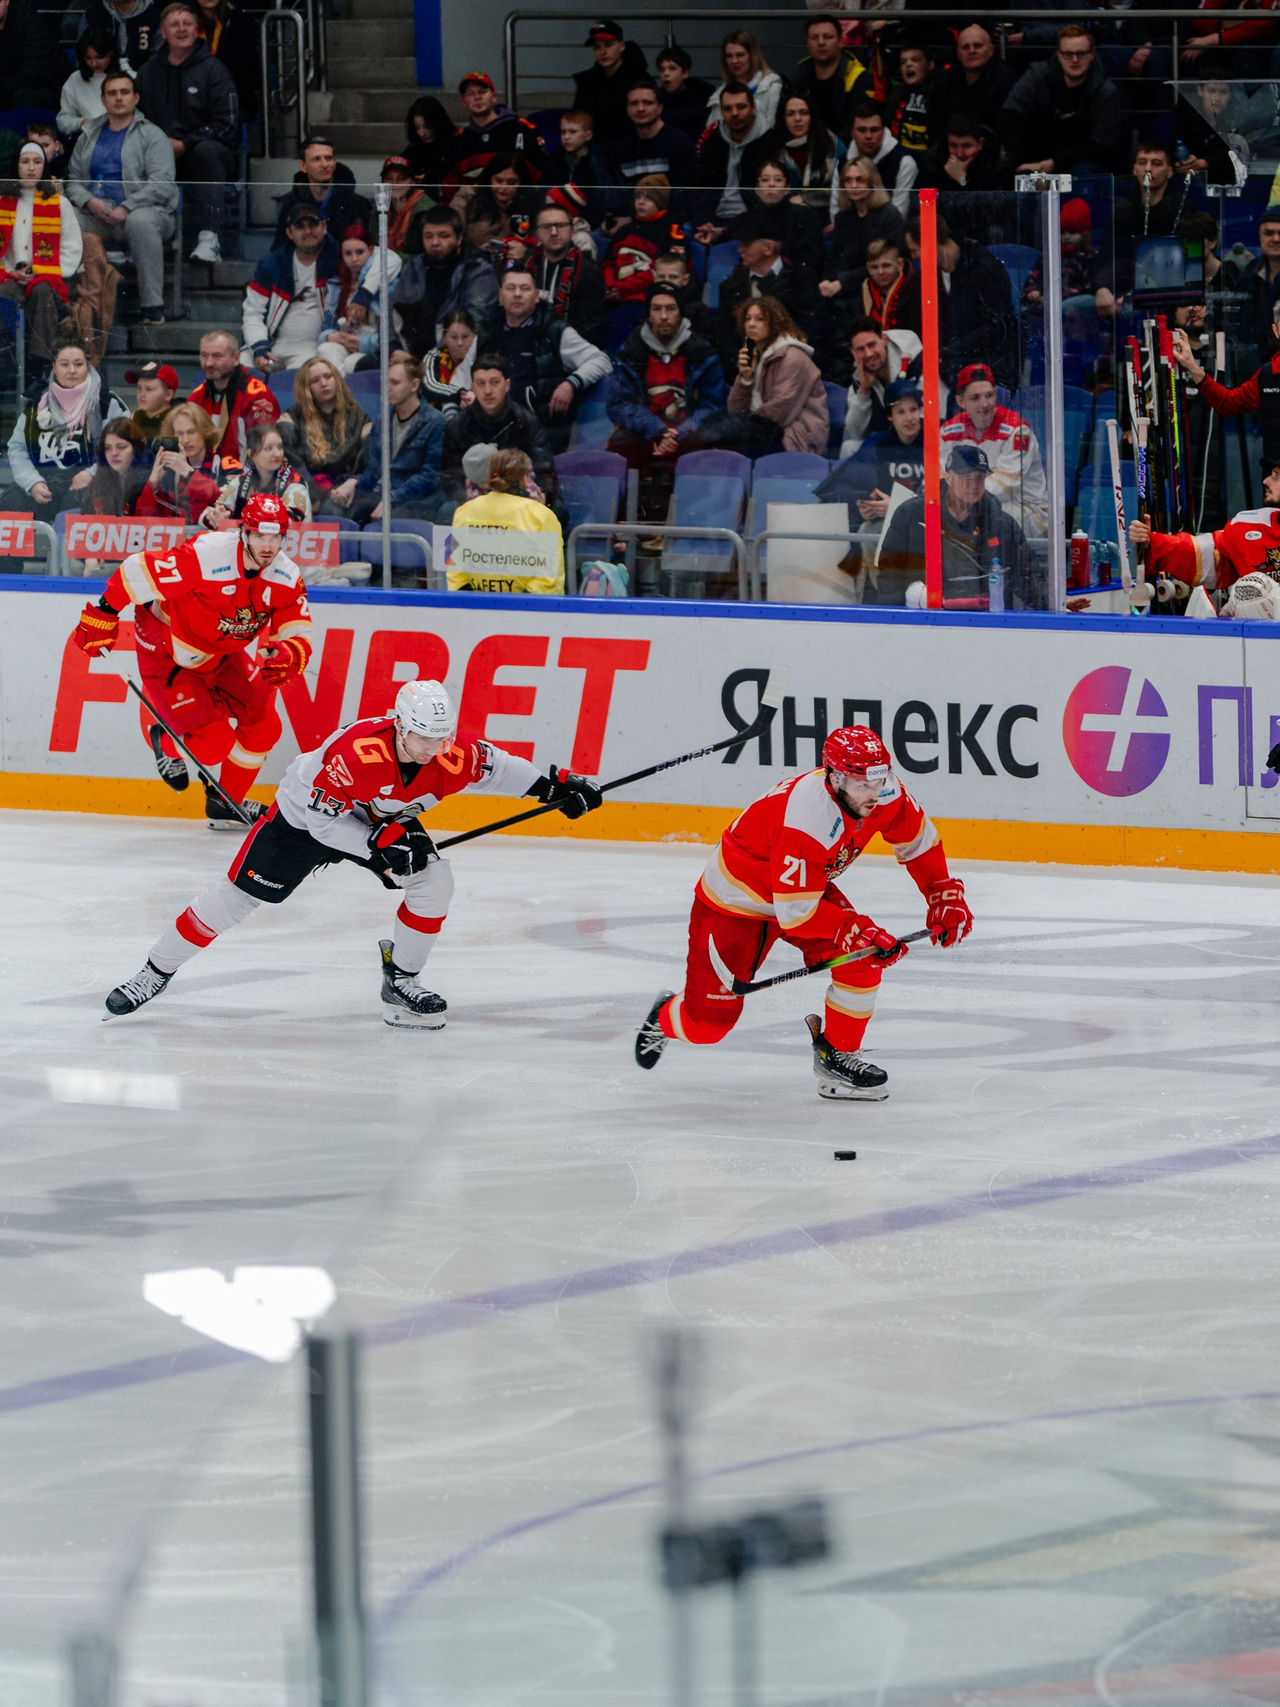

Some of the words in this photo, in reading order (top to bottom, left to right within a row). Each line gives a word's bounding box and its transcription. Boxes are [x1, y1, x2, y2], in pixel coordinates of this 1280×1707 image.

[67, 521, 184, 552] FONBET
[153, 555, 183, 584] 27
[462, 548, 548, 568] Ростелеком
[261, 586, 272, 606] A
[80, 613, 119, 632] WARRIO
[48, 618, 651, 776] FNBET
[431, 702, 447, 715] 13
[655, 744, 715, 774] BAUER
[867, 768, 888, 776] согаз
[307, 787, 346, 818] 13
[829, 816, 843, 839] SIBUR
[779, 855, 807, 888] 21
[770, 967, 810, 987] BAUER
